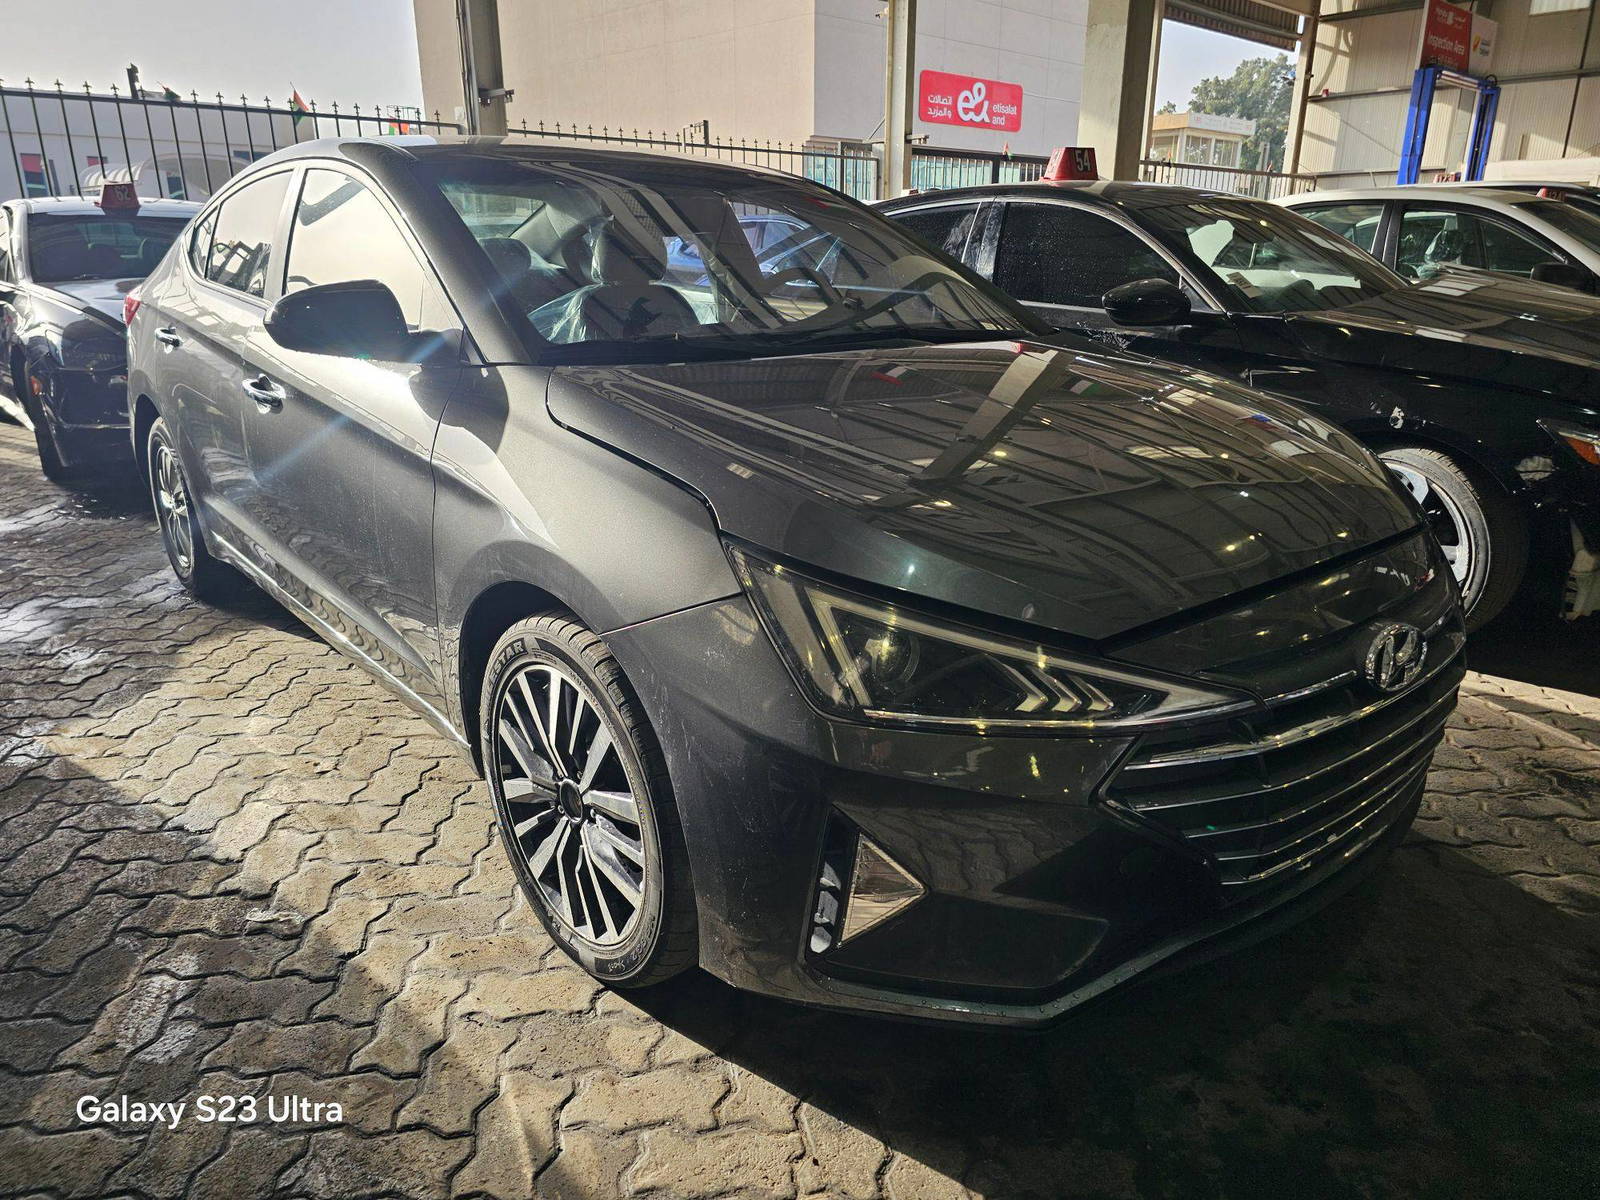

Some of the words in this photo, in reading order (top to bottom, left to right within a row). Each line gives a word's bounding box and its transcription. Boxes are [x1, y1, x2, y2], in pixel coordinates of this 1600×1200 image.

[992, 103, 1017, 115] etisalat
[992, 115, 1005, 126] and
[1075, 149, 1091, 172] 54
